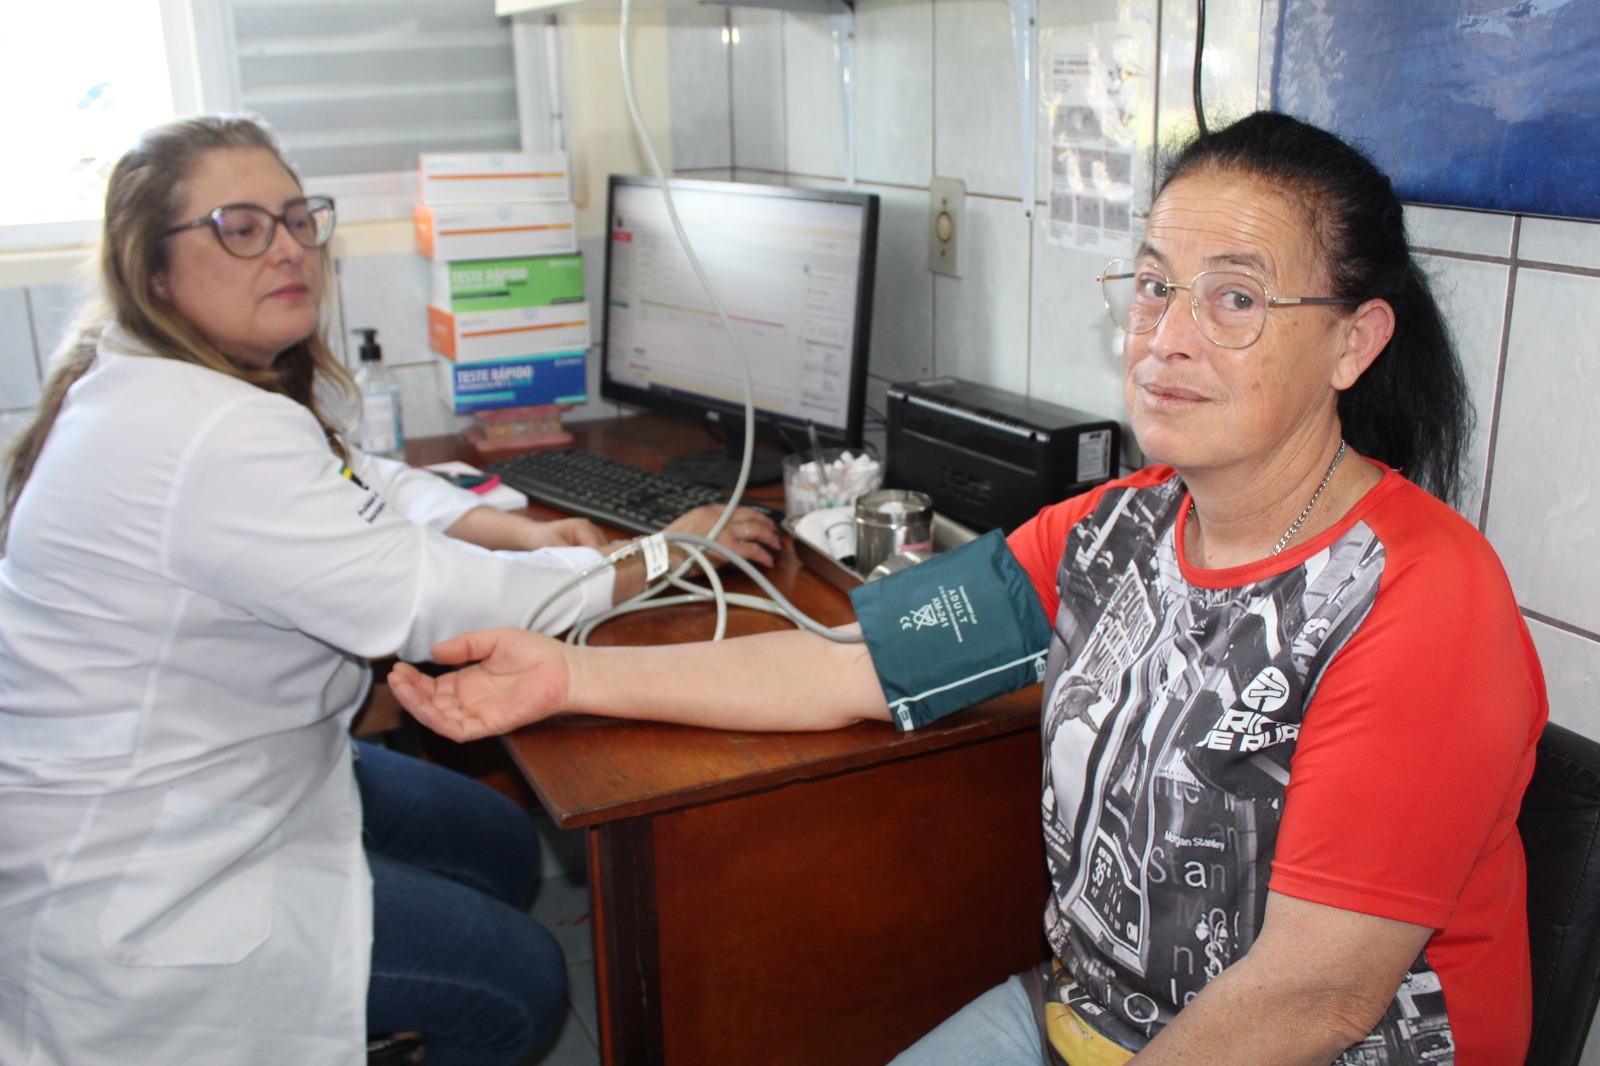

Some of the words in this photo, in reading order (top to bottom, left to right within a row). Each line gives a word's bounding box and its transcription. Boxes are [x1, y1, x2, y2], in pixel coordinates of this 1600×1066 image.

[452, 269, 482, 285] TESTE
[457, 369, 488, 384] TESTE
[932, 597, 949, 627] KM-241
[948, 590, 968, 623] ADULT
